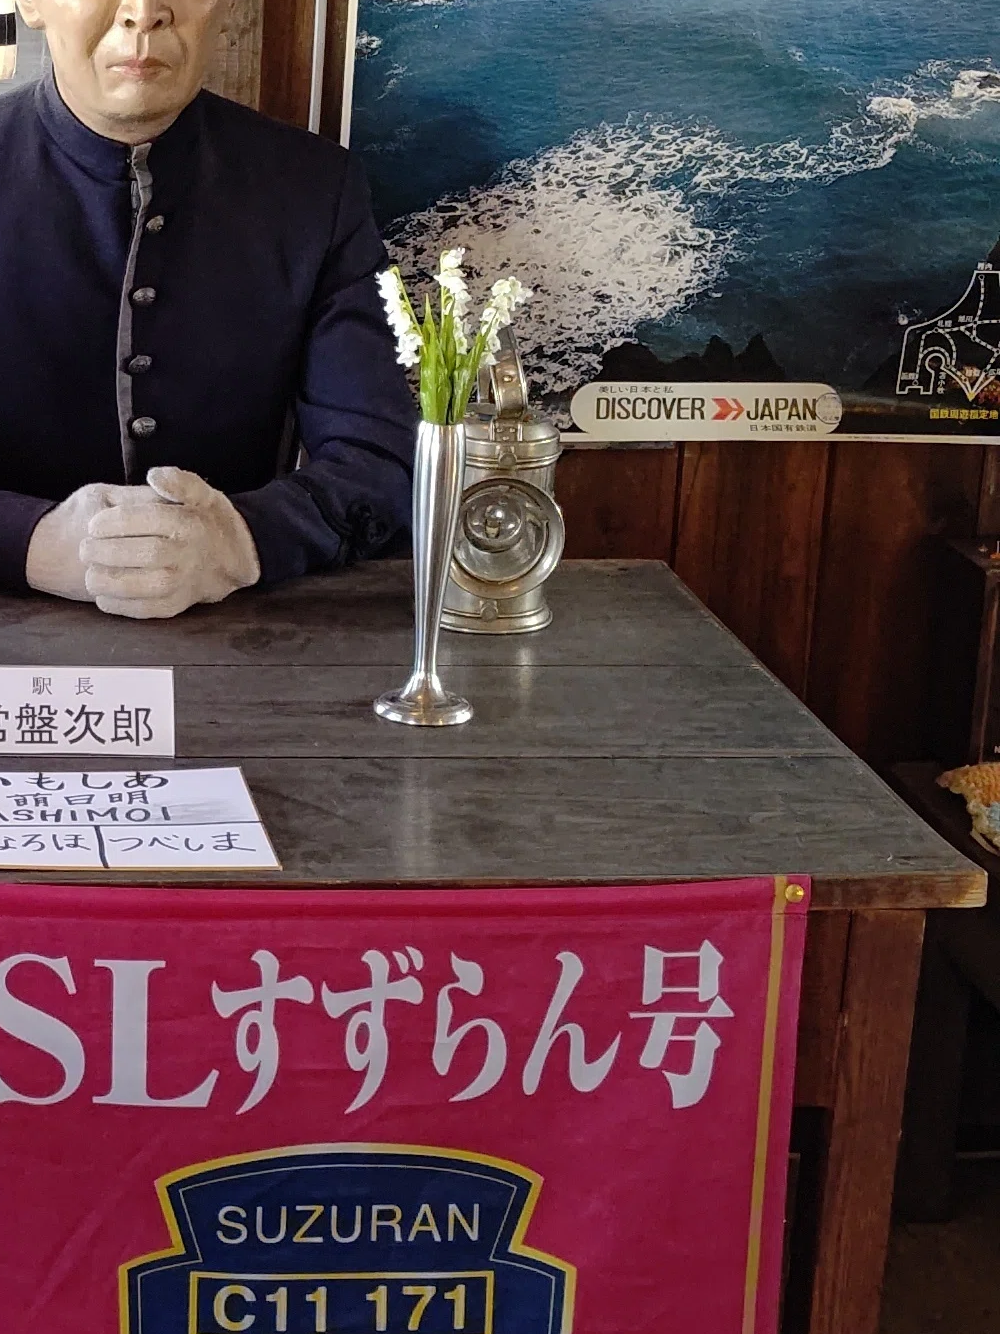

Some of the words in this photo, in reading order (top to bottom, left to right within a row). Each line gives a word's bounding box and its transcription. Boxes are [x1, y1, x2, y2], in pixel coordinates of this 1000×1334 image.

[595, 397, 705, 420] DISCOVER
[746, 398, 817, 421] JAPAN
[32, 676, 94, 696] 駅長
[216, 1202, 481, 1245] SUZURAN
[213, 1285, 330, 1333] C11
[366, 1284, 467, 1332] 171
